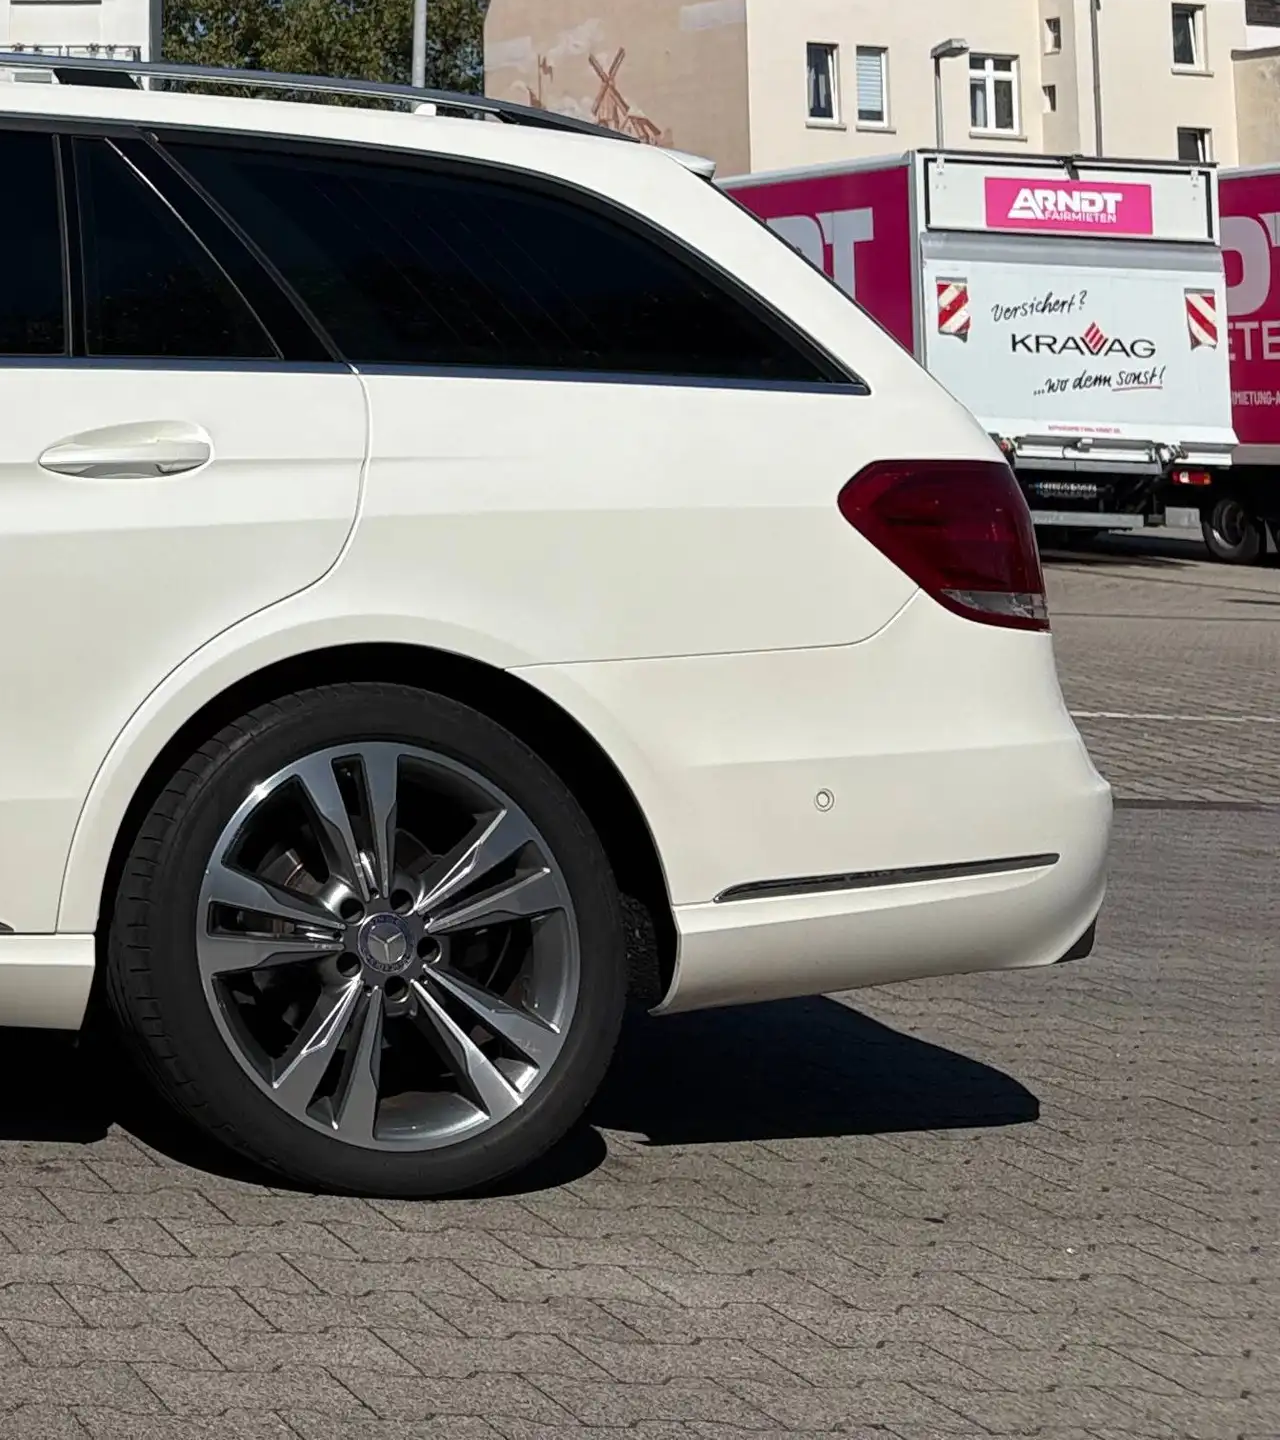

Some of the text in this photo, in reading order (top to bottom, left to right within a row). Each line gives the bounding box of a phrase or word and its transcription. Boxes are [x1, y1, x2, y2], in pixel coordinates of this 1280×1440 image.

[1007, 188, 1123, 221] ARNDT
[1044, 211, 1117, 224] FAIRMIETEN
[1011, 333, 1157, 359] KRAVAG
